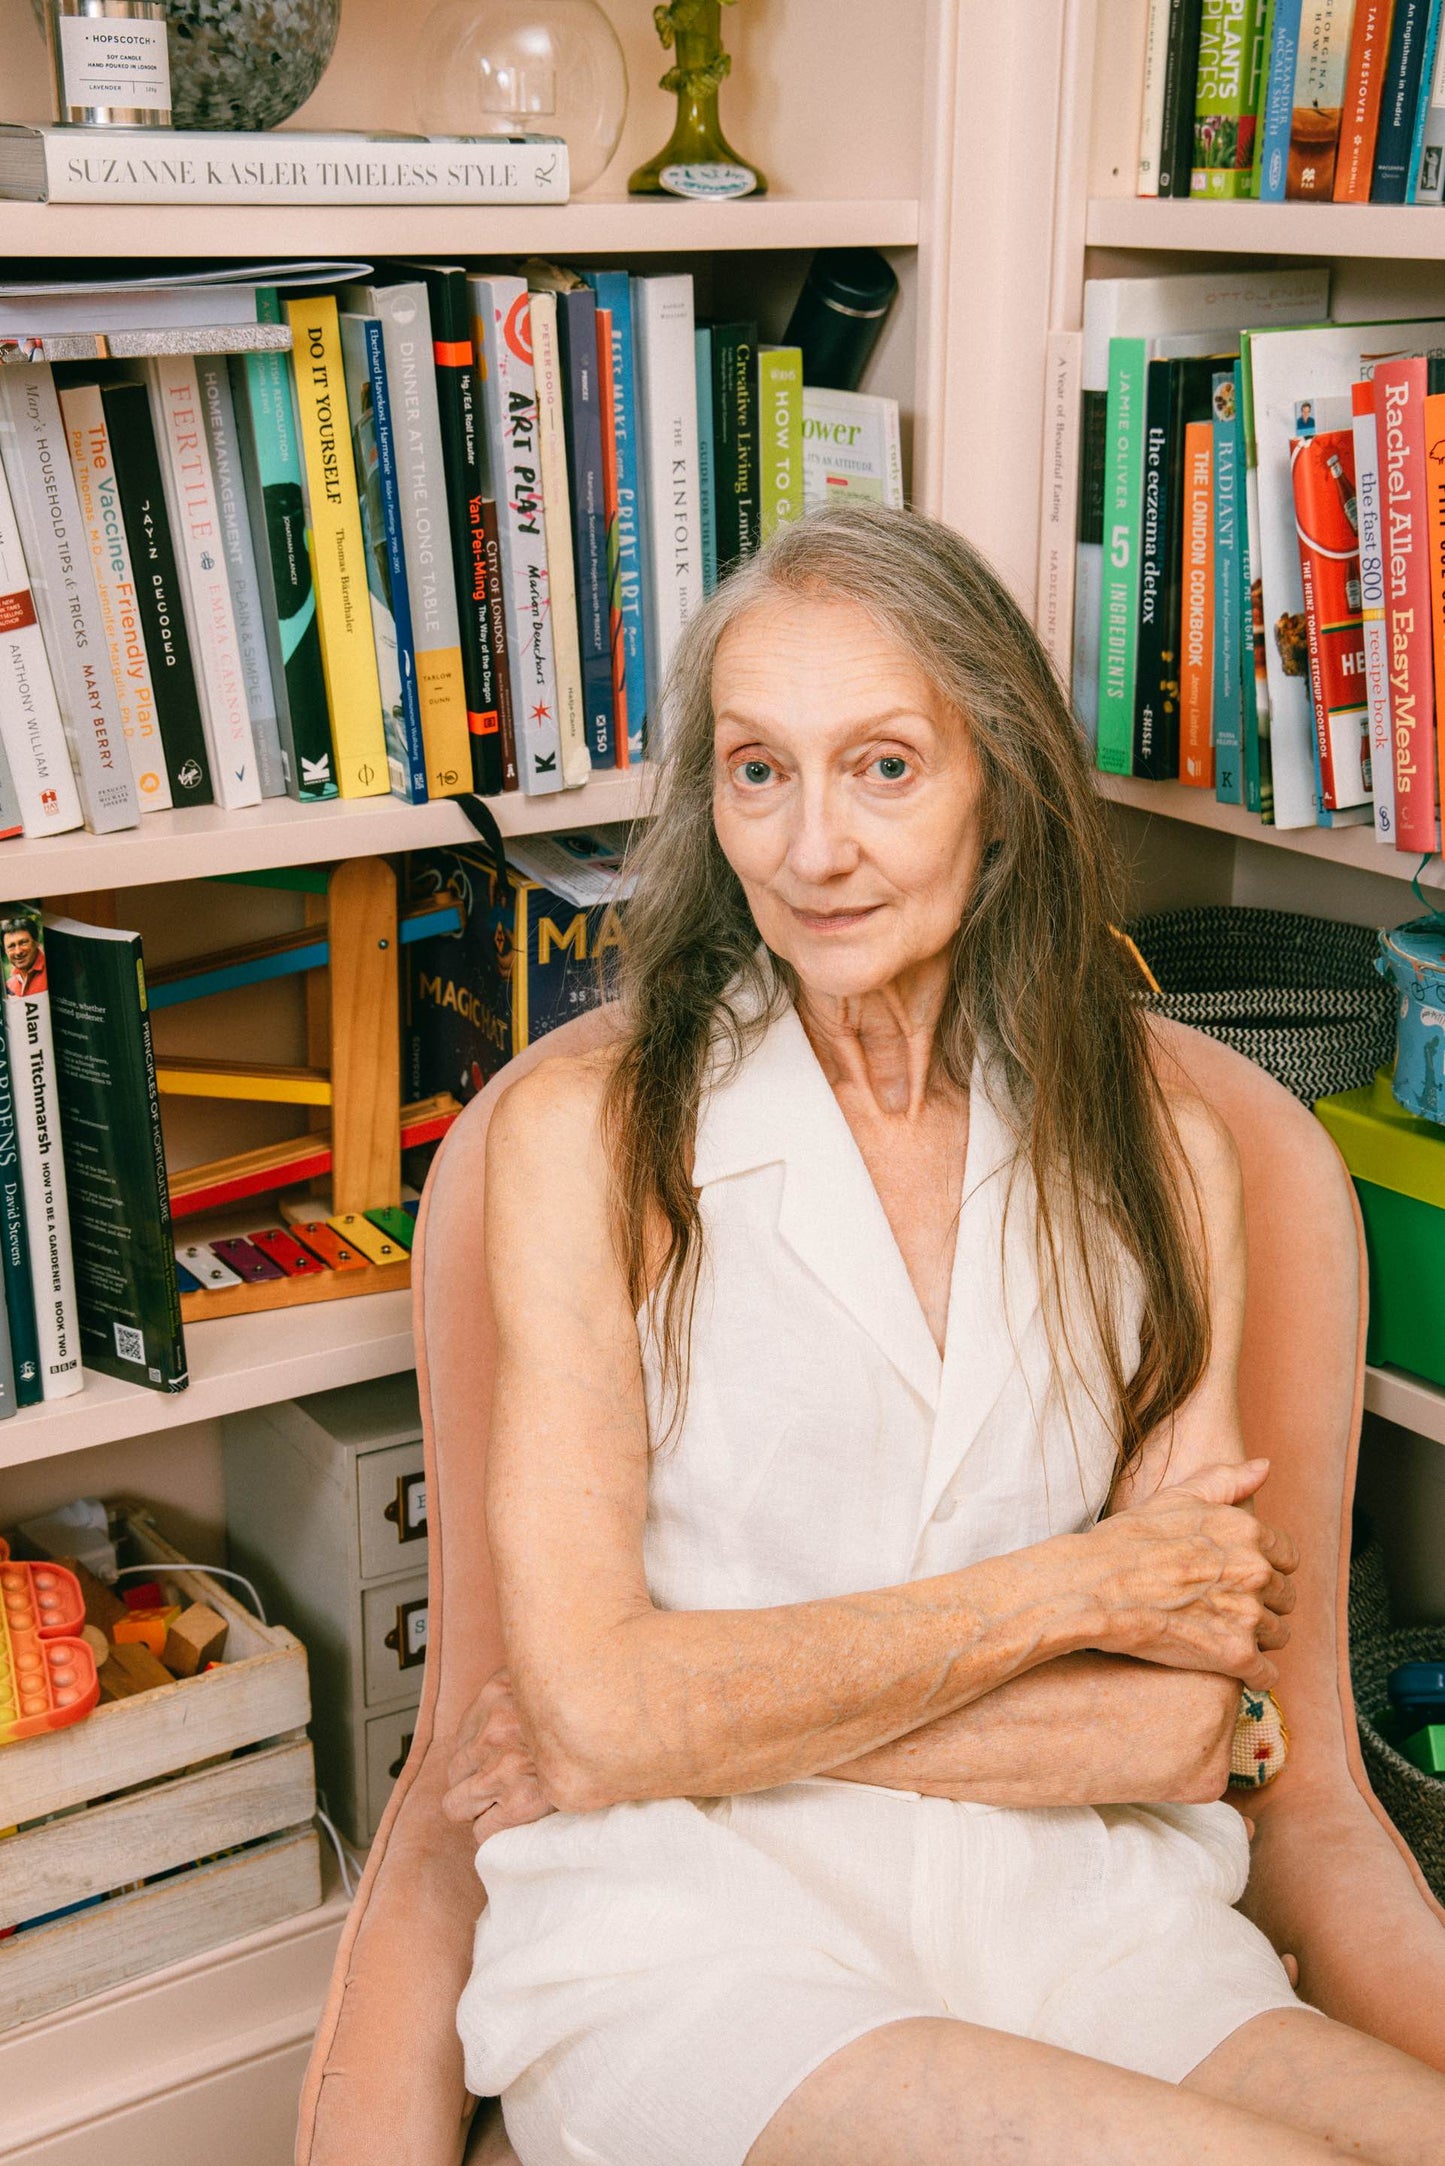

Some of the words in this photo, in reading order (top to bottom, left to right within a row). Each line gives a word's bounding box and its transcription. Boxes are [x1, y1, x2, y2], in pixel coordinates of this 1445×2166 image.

[1365, 8, 1376, 41] TARA
[1407, 3, 1416, 18] An
[92, 34, 151, 45] HOPSCOTCH
[1219, 0, 1244, 98] PLANTS
[1271, 27, 1286, 86] McCALL
[1309, 13, 1322, 84] HOWELL
[1318, 0, 1332, 90] GEORGINA
[1399, 20, 1414, 78] Englishman
[1280, 38, 1294, 124] ALEXANDER
[1356, 49, 1373, 123] WESTOVER
[1398, 80, 1406, 90] in
[1269, 88, 1282, 136] SMITH
[1393, 92, 1405, 127] Madrid
[66, 157, 197, 187] SUZANNE
[206, 161, 308, 187] KASLER
[315, 163, 440, 189] TIMELESS
[445, 164, 520, 189] STYLE
[1348, 149, 1362, 194] WINDMILL
[307, 326, 325, 360] DO
[369, 329, 383, 376] Eberhard
[542, 323, 552, 371] PETER
[1058, 358, 1067, 367] A
[311, 364, 329, 389] IT
[401, 342, 420, 421] DINNER
[544, 371, 555, 405] DOIG
[736, 343, 751, 427] Creative
[1057, 371, 1067, 403] Year
[373, 378, 388, 425] Havekost.
[464, 413, 474, 433] Rolf
[507, 391, 535, 452] ART
[775, 391, 790, 449] HOW
[1056, 405, 1066, 420] of
[1118, 371, 1131, 431] JAMIE
[72, 430, 85, 464] Paul
[272, 386, 290, 463] REVOLUTION
[407, 432, 424, 456] AT
[673, 418, 684, 447] THE
[1148, 427, 1166, 466] the
[1384, 381, 1411, 504] Rachel
[168, 385, 213, 540] FERTILE
[314, 391, 343, 506] YOURSELF
[379, 426, 392, 476] Harmonie
[465, 434, 476, 467] Lauter
[700, 441, 709, 486] GUIDE
[735, 432, 752, 493] Living
[821, 455, 834, 467] AN
[833, 456, 874, 473] ATTITUDE
[1054, 421, 1066, 479] Beautiful
[1193, 450, 1210, 486] THE
[411, 462, 428, 502] THE
[586, 470, 595, 514] Managing
[775, 457, 791, 490] TO
[1115, 436, 1130, 511] OLIVER
[1217, 441, 1235, 549] RADIANT
[1361, 472, 1377, 506] the
[22, 383, 47, 433] Mary's
[36, 438, 66, 539] HOUSEHOLD
[55, 541, 73, 575] TIPS
[67, 594, 89, 648] TRICKS
[211, 429, 243, 566] MANAGEMENT
[468, 495, 483, 525] Yan
[513, 466, 542, 534] PLAY
[672, 459, 690, 576] KINFOLK
[701, 489, 709, 515] FOR
[1050, 479, 1064, 524] Eating
[1143, 471, 1162, 556] eczema
[282, 515, 295, 552] JONATHAN
[415, 508, 435, 566] LONG
[588, 515, 599, 558] Successful
[1110, 524, 1130, 568] 5
[1190, 490, 1208, 565] LONDON
[1363, 509, 1379, 551] fast
[287, 553, 299, 587] GLANCEY
[335, 528, 348, 573] Thomas
[470, 528, 487, 601] Pei-Ming
[486, 541, 498, 575] CITY
[1302, 560, 1312, 580] THE
[1388, 506, 1413, 600] Allen
[88, 423, 107, 470] The
[98, 476, 145, 680] Vaccine-Friendly
[134, 687, 155, 738] Plan
[489, 577, 500, 595] OF
[527, 564, 541, 618] Marion
[590, 559, 600, 592] Projects
[620, 567, 640, 617] ART
[1048, 550, 1059, 629] MADELEINE
[1142, 558, 1161, 625] detox
[1304, 582, 1315, 611] HEINZ
[1361, 557, 1383, 602] 800
[152, 575, 176, 666] DECODED
[422, 571, 441, 633] TABLE
[477, 605, 487, 621] The
[592, 593, 601, 612] with
[678, 586, 690, 626] HOME
[1188, 570, 1206, 667] COOKBOOK
[235, 579, 251, 628] PLAIN
[244, 647, 261, 706] SIMPLE
[478, 622, 489, 641] Way
[481, 642, 490, 652] of
[490, 597, 504, 655] LONDON
[1106, 582, 1128, 699] INGREDIENTS
[1245, 609, 1255, 651] VEGAN
[1306, 613, 1318, 654] TOMATO
[209, 584, 228, 645] EMMA
[219, 653, 245, 741] CANNON
[480, 653, 490, 669] the
[531, 621, 547, 686] Deuchars
[1369, 628, 1382, 694] recipe
[1390, 608, 1415, 693] Easy
[422, 671, 452, 684] TARLOW
[482, 670, 493, 703] Dragon
[1189, 674, 1199, 706] Jenny
[1311, 657, 1322, 701] KETCHUP
[10, 644, 35, 713] ANTHONY
[26, 717, 50, 779] WILLIAM
[83, 664, 102, 711] MARY
[93, 717, 114, 770] BERRY
[405, 679, 417, 725] Kunstmuseum
[428, 697, 451, 706] DUNN
[1372, 698, 1389, 750] book
[596, 728, 608, 753] TSO
[1188, 707, 1198, 747] Linford
[1315, 703, 1328, 758] COOKBOOK
[1395, 694, 1418, 794] Meals
[534, 752, 556, 774] K
[1221, 771, 1233, 788] K
[24, 1001, 39, 1045] Alan
[419, 971, 480, 1030] MAGIC
[479, 1006, 508, 1051] HAT
[142, 1021, 157, 1100] PRINCIPLES
[30, 1049, 51, 1154] Titchmarsh
[149, 1101, 160, 1121] OF
[41, 1162, 52, 1187] HOW
[44, 1189, 54, 1204] TO
[152, 1124, 170, 1225] HORTICULTURE
[4, 1182, 18, 1221] David
[46, 1206, 56, 1222] BE
[8, 1222, 22, 1267] Stevens
[47, 1224, 57, 1232] A
[48, 1234, 62, 1292] GARDENER
[54, 1300, 66, 1331] BOOK
[50, 1360, 77, 1374] BBC
[58, 1333, 68, 1358] TWO
